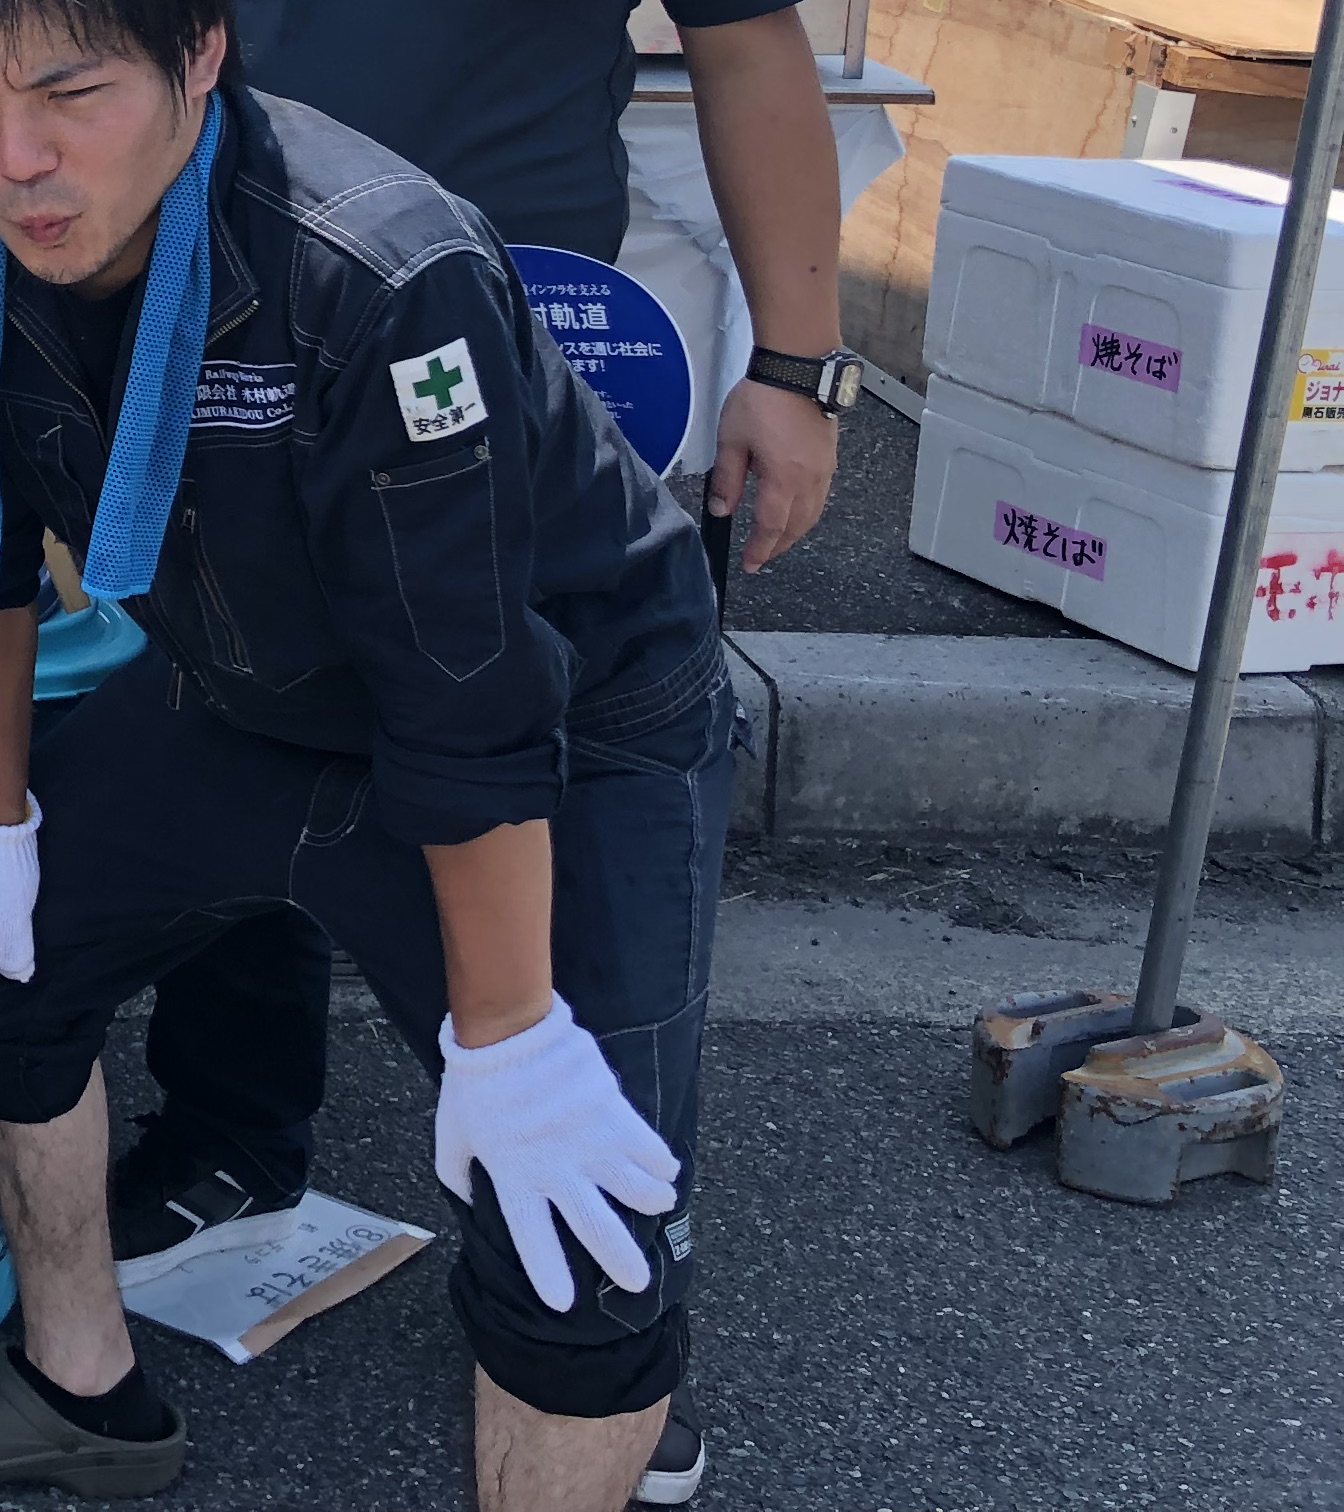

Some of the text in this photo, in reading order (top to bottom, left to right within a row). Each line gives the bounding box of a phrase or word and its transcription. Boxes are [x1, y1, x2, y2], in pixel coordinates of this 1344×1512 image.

[558, 340, 664, 357] スを通じ社会に
[1091, 333, 1179, 381] 焼そば
[566, 358, 607, 373] ます!
[1306, 380, 1344, 403] ジョナ
[412, 402, 476, 437] 安全第一
[1003, 508, 1104, 567] 焼そば
